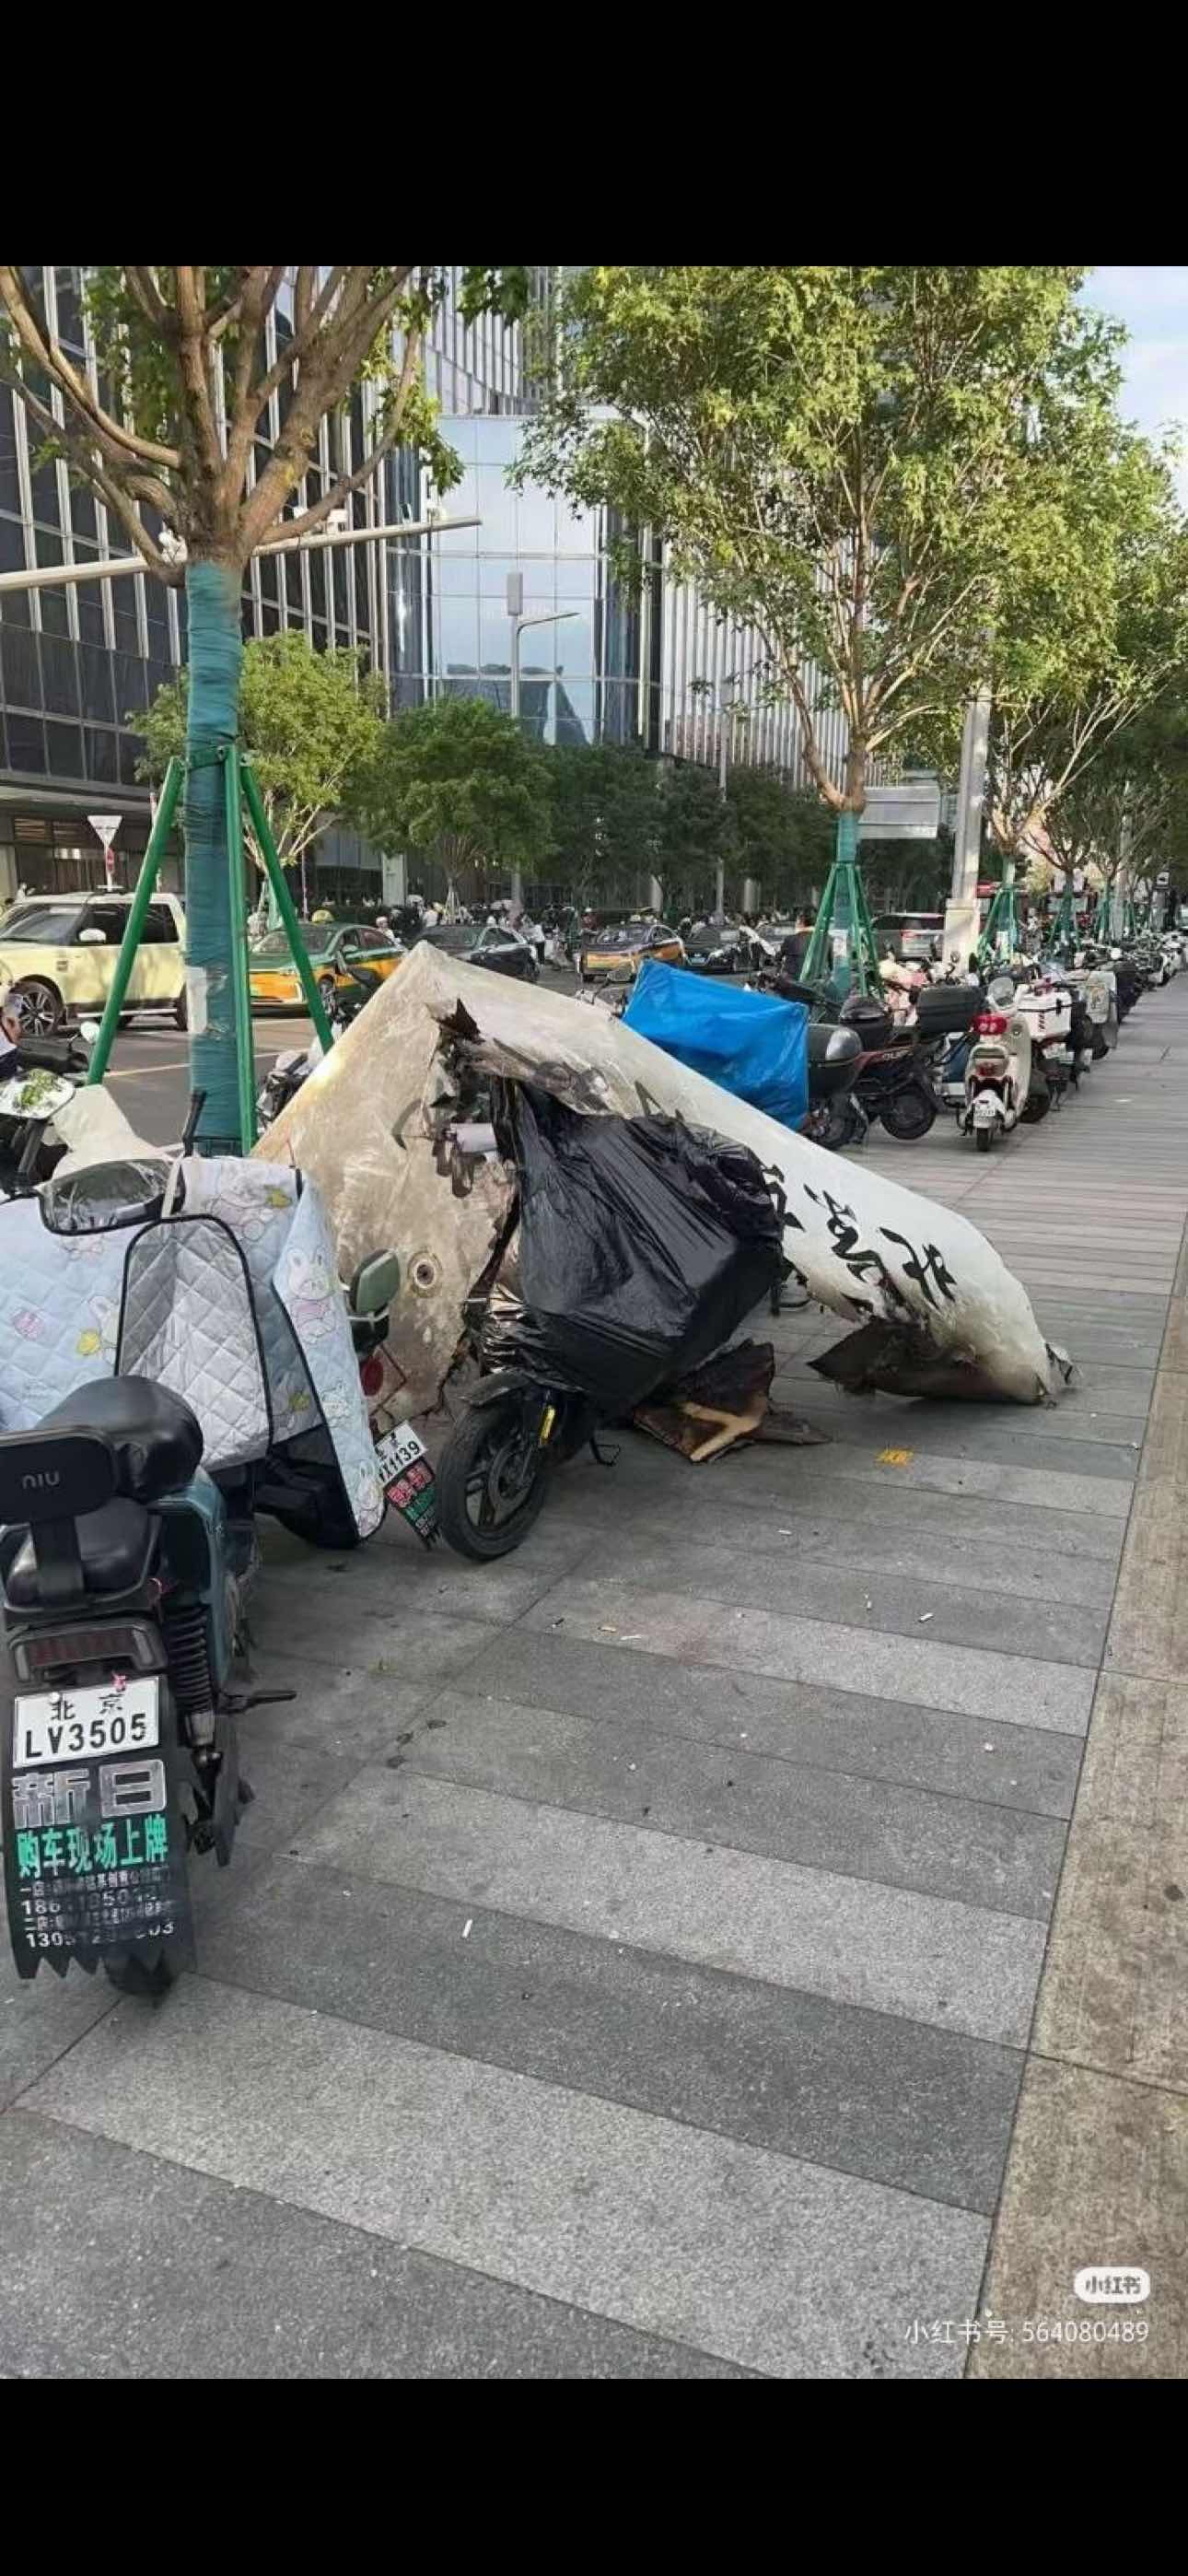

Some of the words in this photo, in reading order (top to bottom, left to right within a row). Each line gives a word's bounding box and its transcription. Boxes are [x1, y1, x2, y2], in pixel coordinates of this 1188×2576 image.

[25, 1713, 147, 1758] LV3505
[11, 1760, 167, 1830] 新日
[17, 1814, 169, 1879] 购车现场上牌
